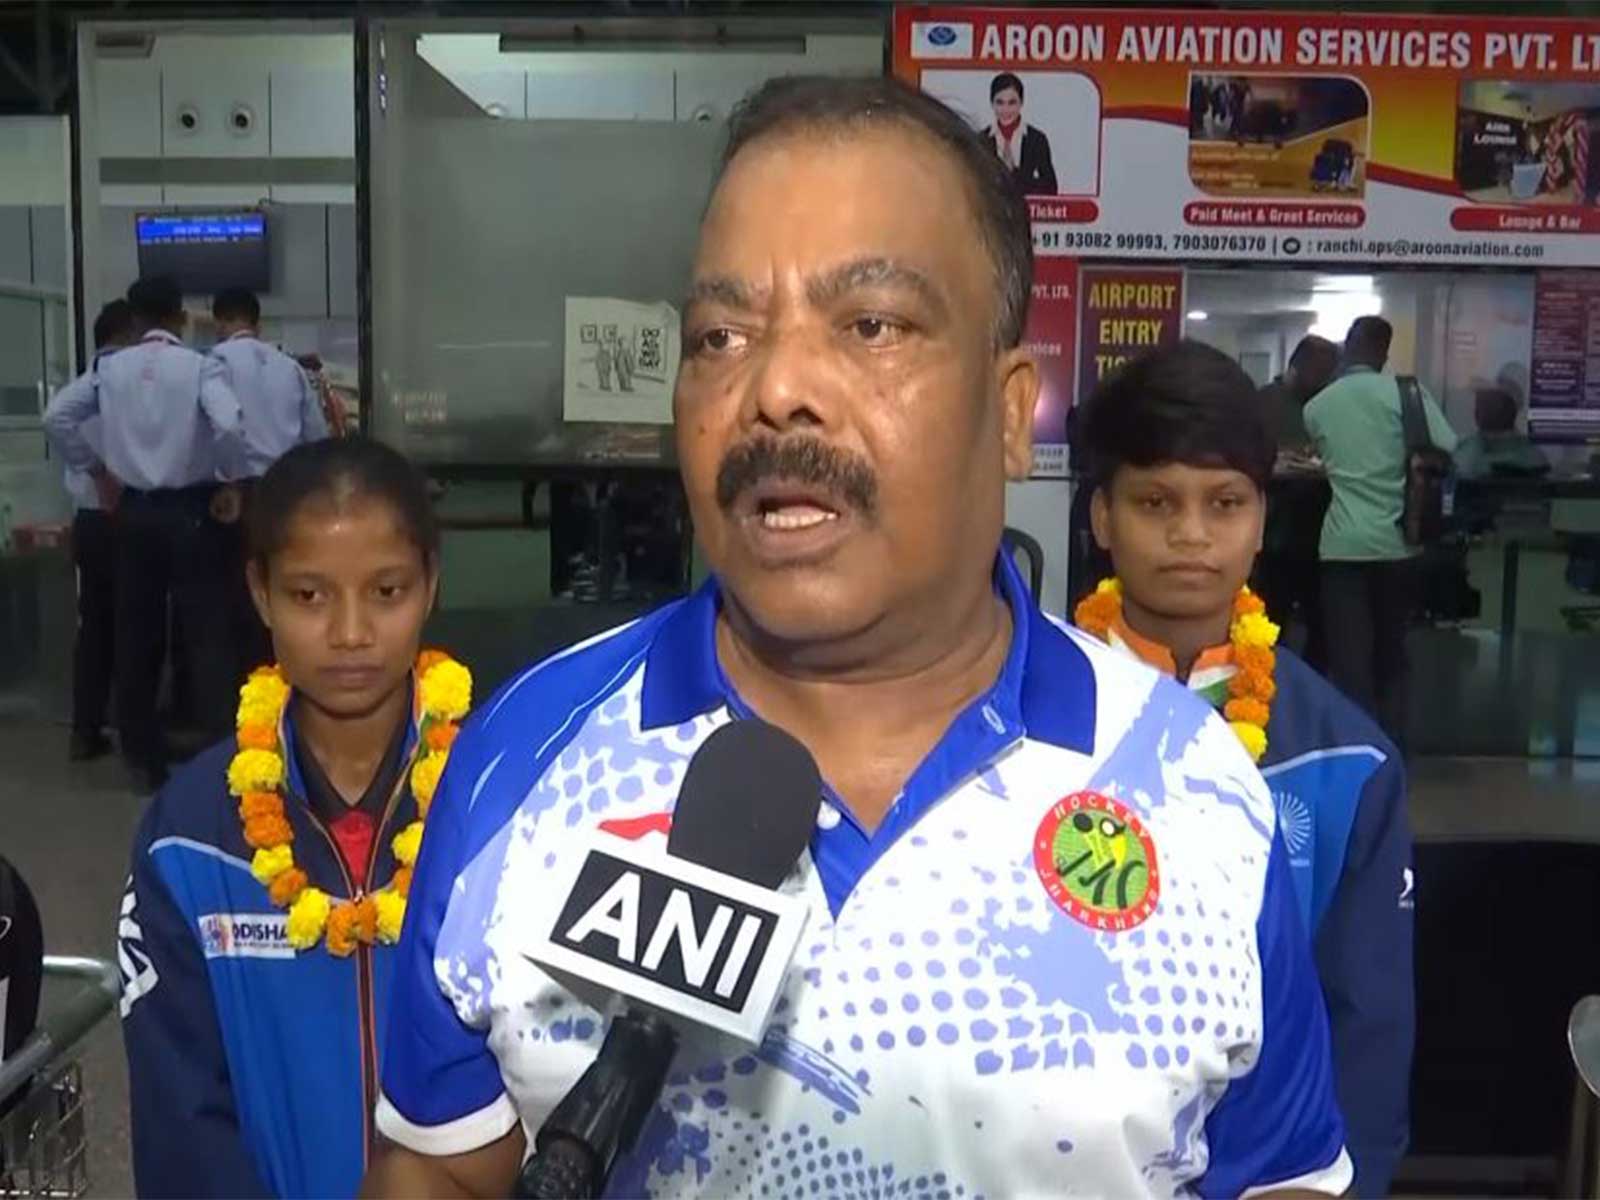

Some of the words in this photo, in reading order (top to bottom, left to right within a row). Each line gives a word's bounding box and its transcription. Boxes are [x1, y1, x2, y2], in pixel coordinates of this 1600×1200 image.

[979, 24, 1105, 61] AROON
[1116, 26, 1284, 64] AVIATION
[1296, 28, 1471, 67] SERVICES
[1484, 32, 1557, 69] PVT.
[1572, 34, 1600, 71] LT
[1189, 207, 1218, 222] Paid
[1222, 208, 1252, 222] Meet
[1307, 209, 1359, 224] Services
[1499, 214, 1542, 230] Lounge
[1560, 215, 1581, 230] Bar
[1065, 232, 1112, 249] 93082
[1173, 234, 1266, 251] 7903076370
[1316, 237, 1545, 258] ranchi.ops@aroonaviation.com
[1088, 282, 1176, 309] AIRPORT
[1099, 319, 1163, 345] ENTRY
[1053, 795, 1149, 837] HOCKEY
[564, 869, 763, 1000] ANI
